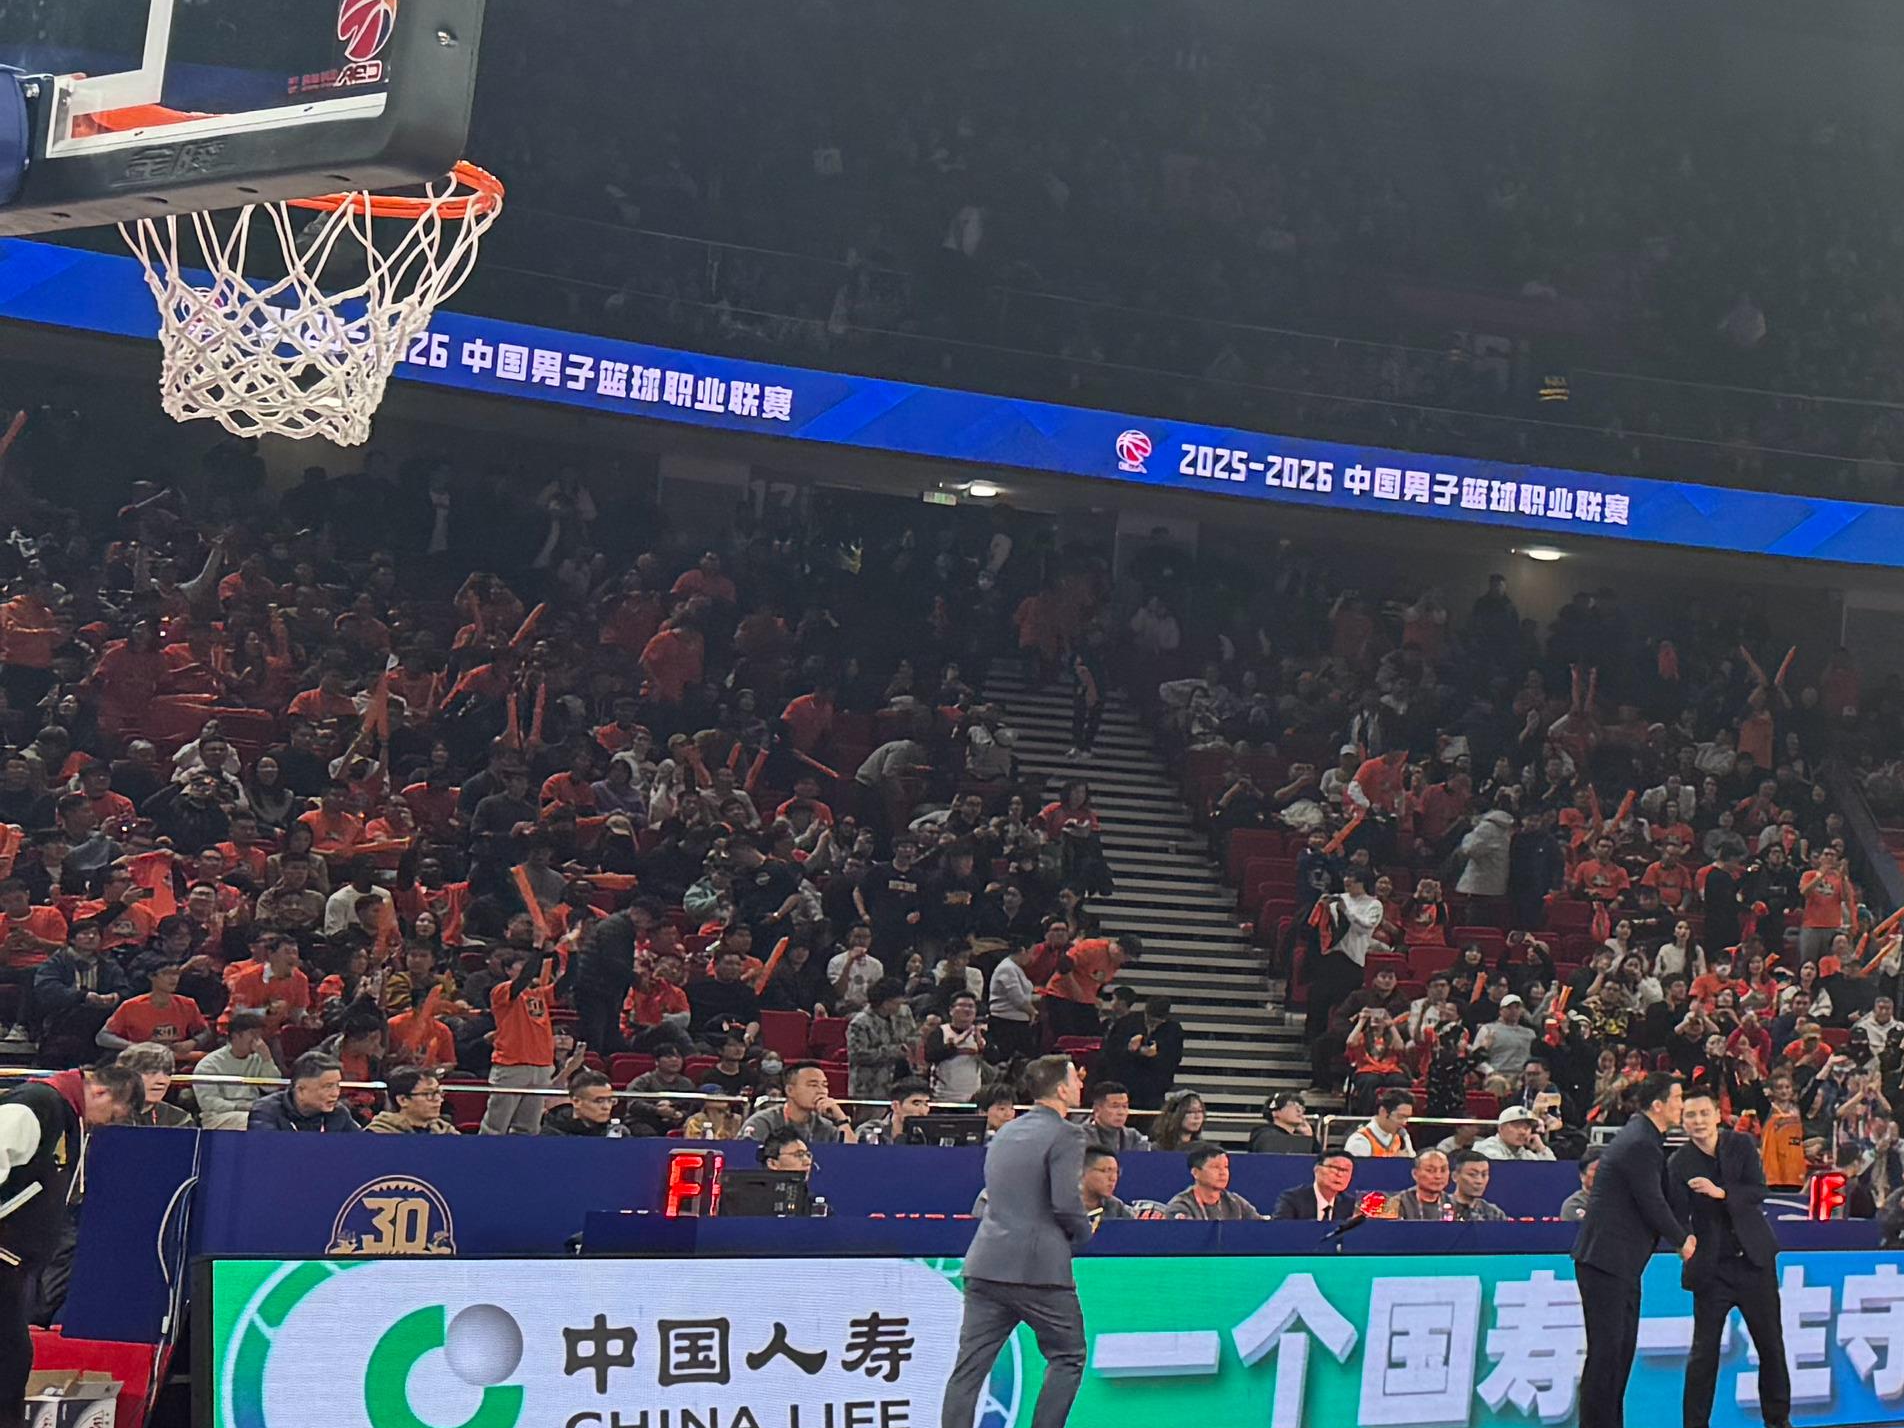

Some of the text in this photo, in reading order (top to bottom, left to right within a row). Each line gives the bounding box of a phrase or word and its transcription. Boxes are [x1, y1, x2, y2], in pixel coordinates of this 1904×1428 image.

[461, 338, 793, 422] 中国男子篮球职业联赛
[1179, 442, 1630, 526] 2025-2026 中国男子篮球职业联赛
[666, 1156, 703, 1217] F
[1809, 1173, 1846, 1223] F
[361, 1197, 429, 1252] 30
[563, 1312, 914, 1394] 中国人寿
